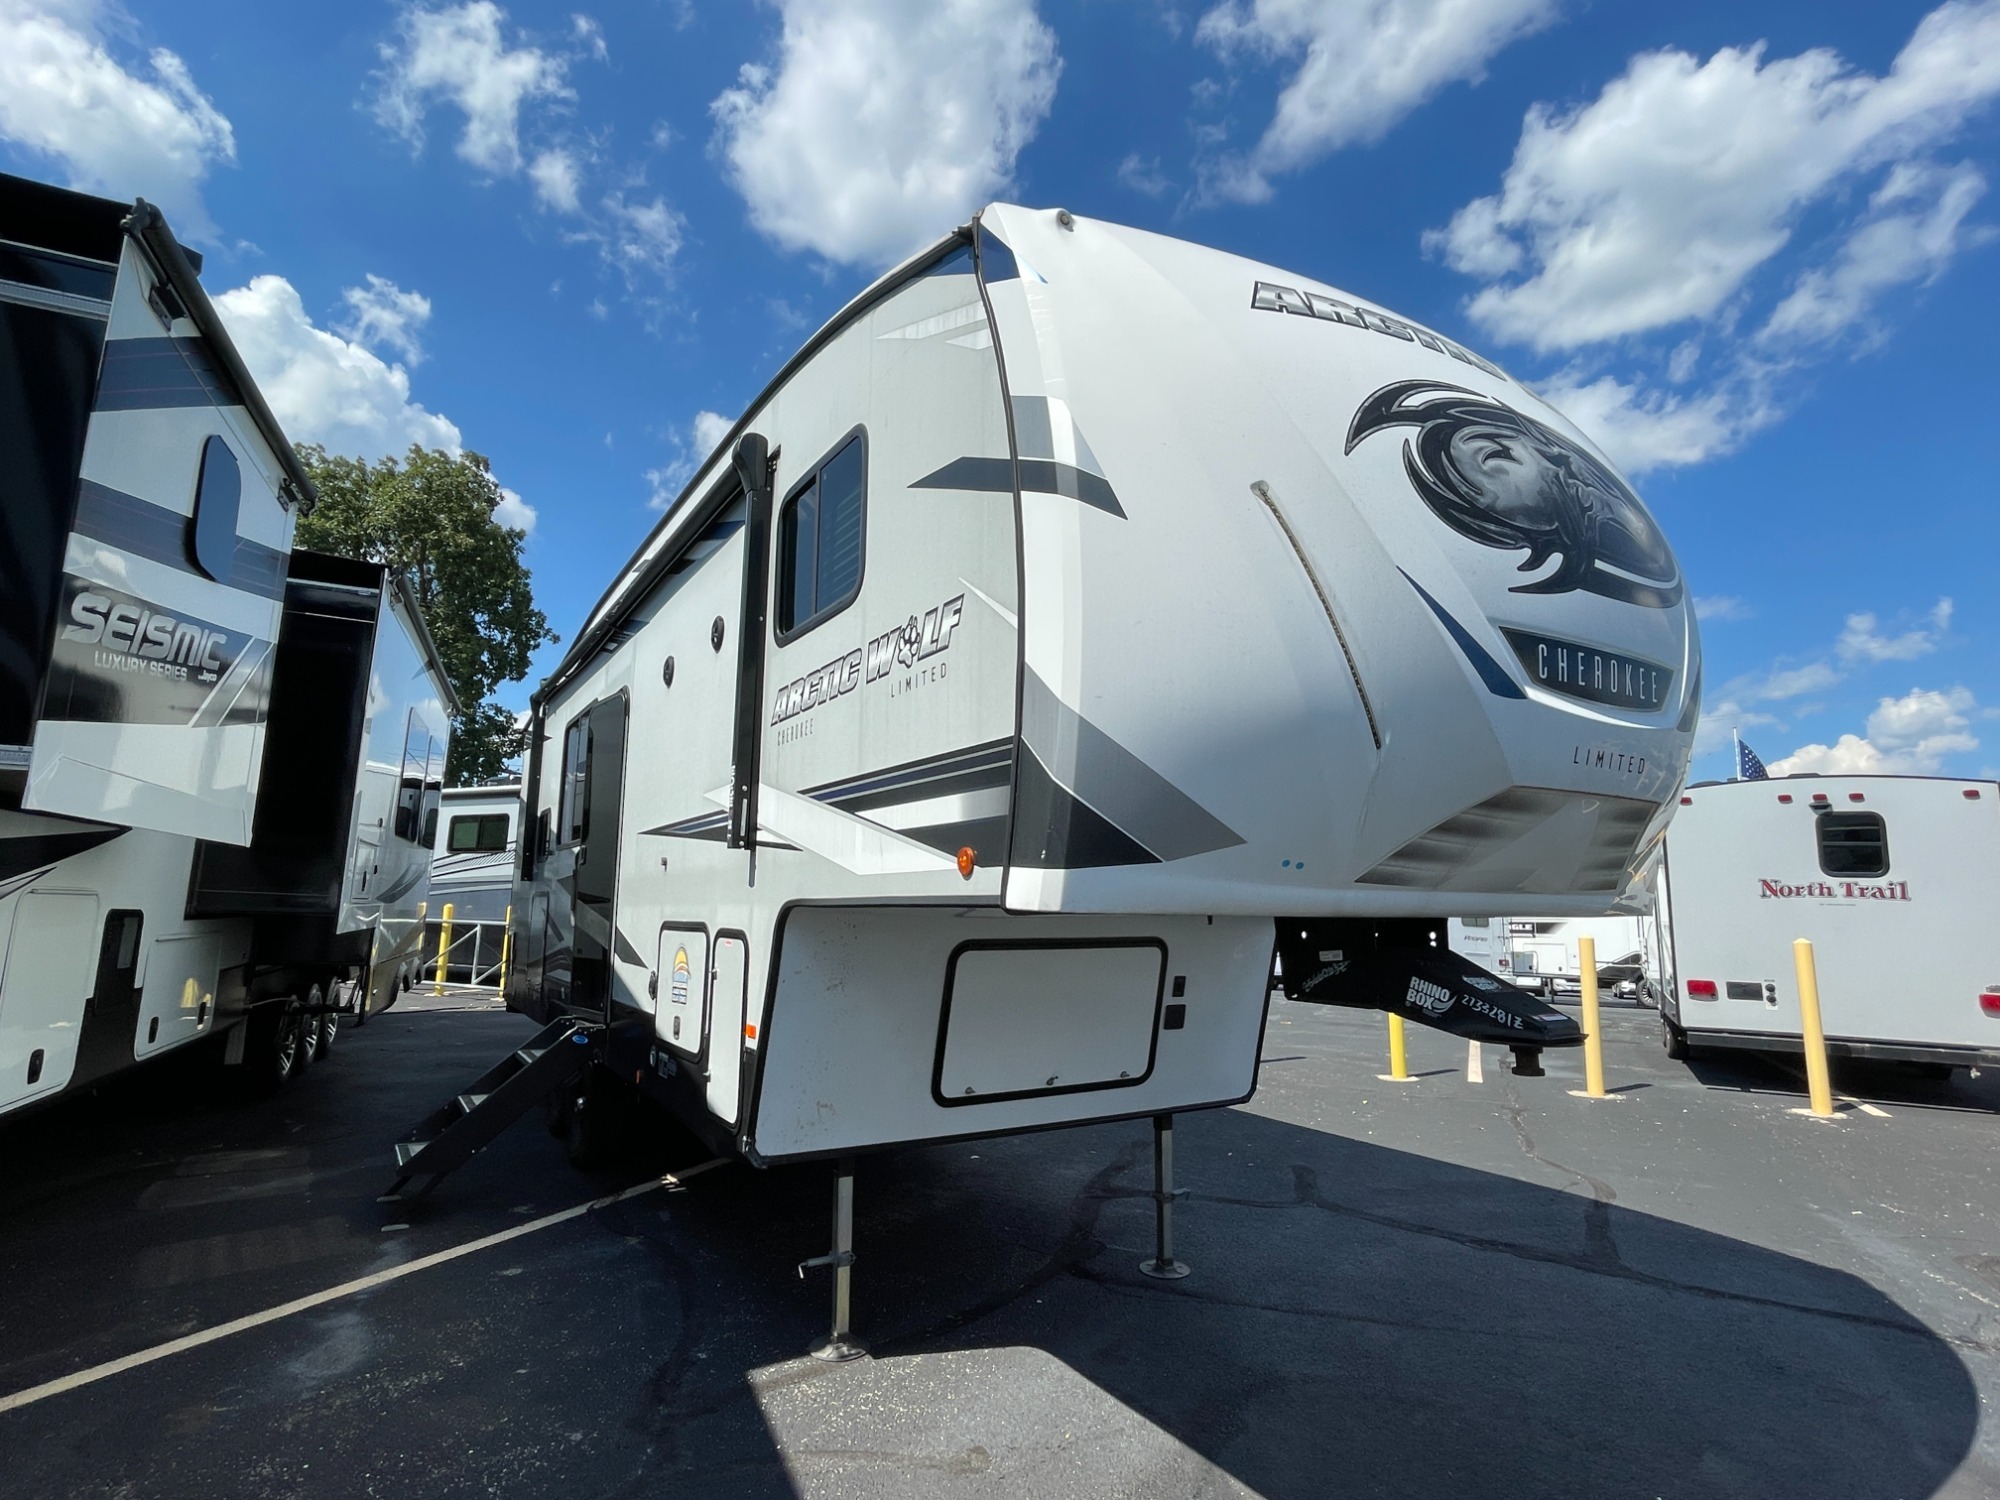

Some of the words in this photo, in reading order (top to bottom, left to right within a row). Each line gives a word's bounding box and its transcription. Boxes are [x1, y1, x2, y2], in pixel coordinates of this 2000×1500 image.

[61, 592, 227, 671] SEISMIC
[94, 651, 147, 674] LUXURY
[150, 661, 188, 682] SERIES
[890, 662, 947, 698] LIMITED
[1538, 643, 1658, 703] CHEROKEE
[770, 648, 862, 727] ARCTIC
[777, 718, 813, 746] CHEROKEE
[1573, 746, 1646, 774] LIMITED
[1758, 878, 1837, 899] North
[1839, 880, 1912, 902] Trail
[1406, 988, 1434, 1010] BOX
[1410, 976, 1450, 1002] RHINO
